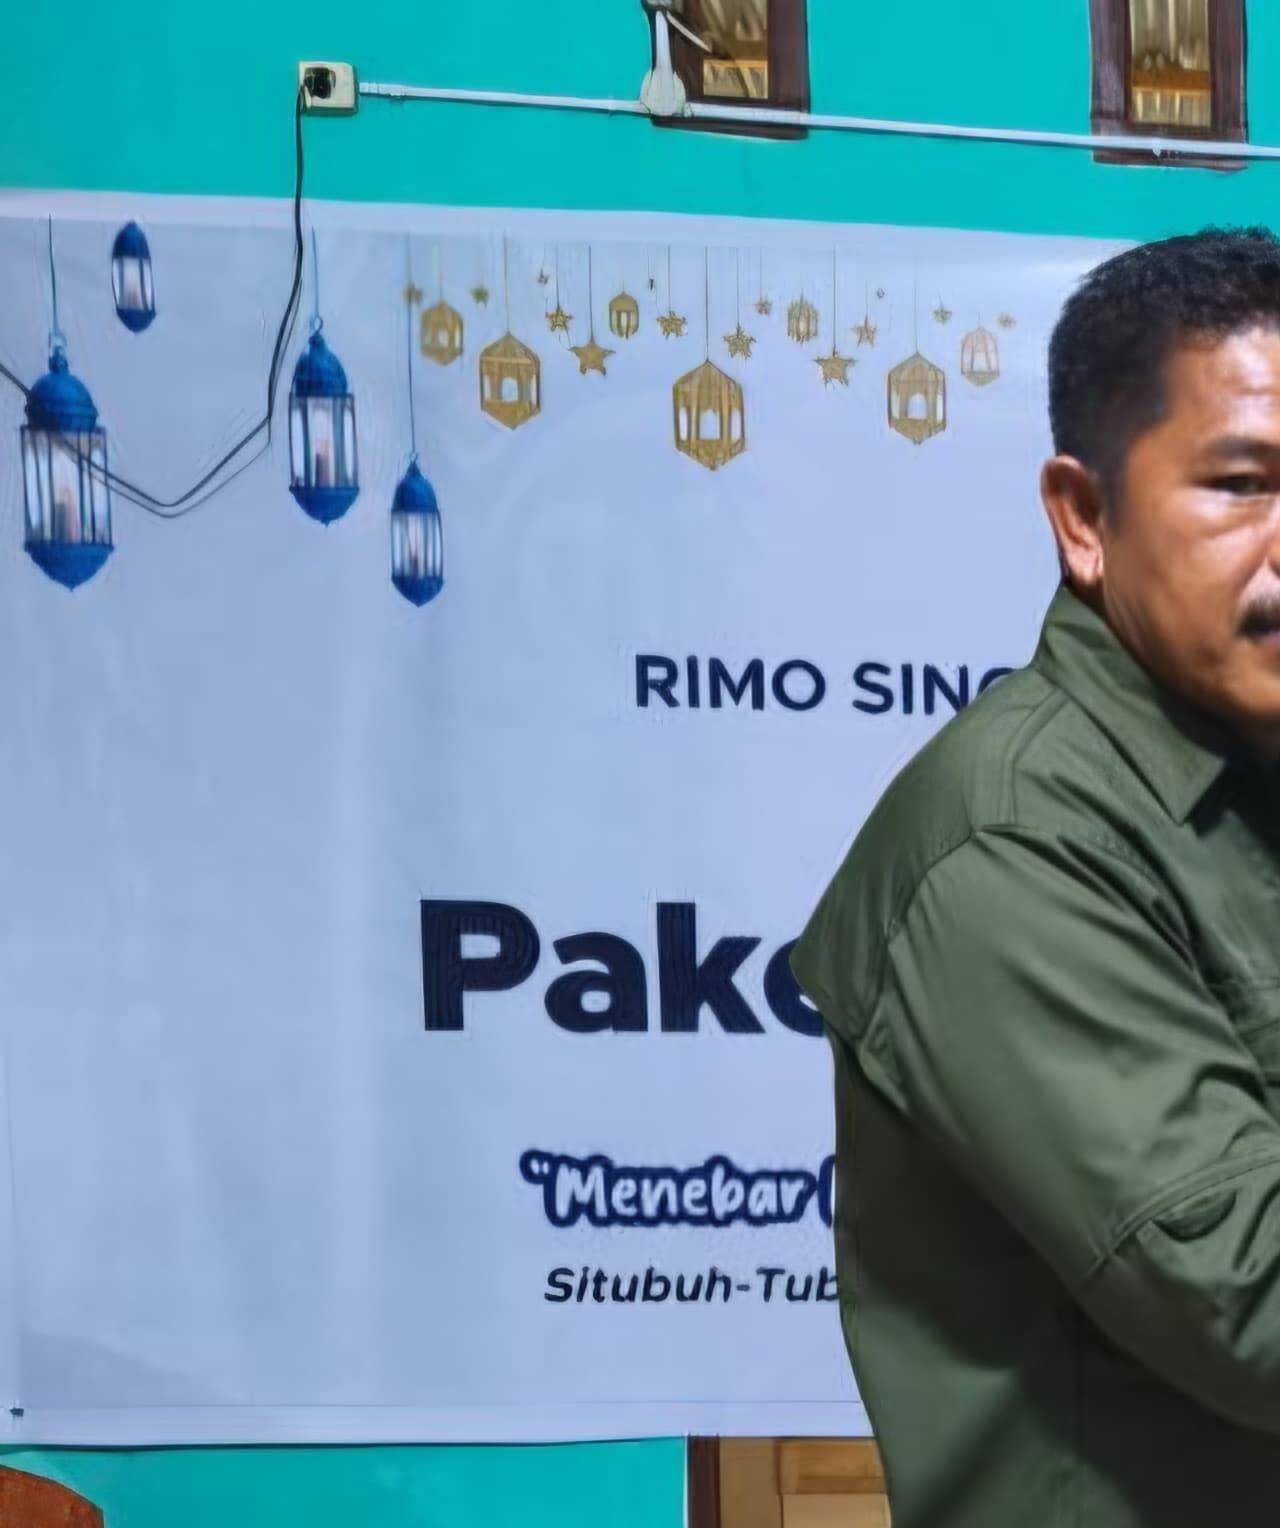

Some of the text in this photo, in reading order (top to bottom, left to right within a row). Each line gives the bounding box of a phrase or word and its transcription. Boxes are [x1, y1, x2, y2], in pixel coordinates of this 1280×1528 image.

[635, 654, 826, 711] RIMO
[852, 662, 1016, 714] SIN
[544, 1266, 840, 1303] Situbuh-Tub
